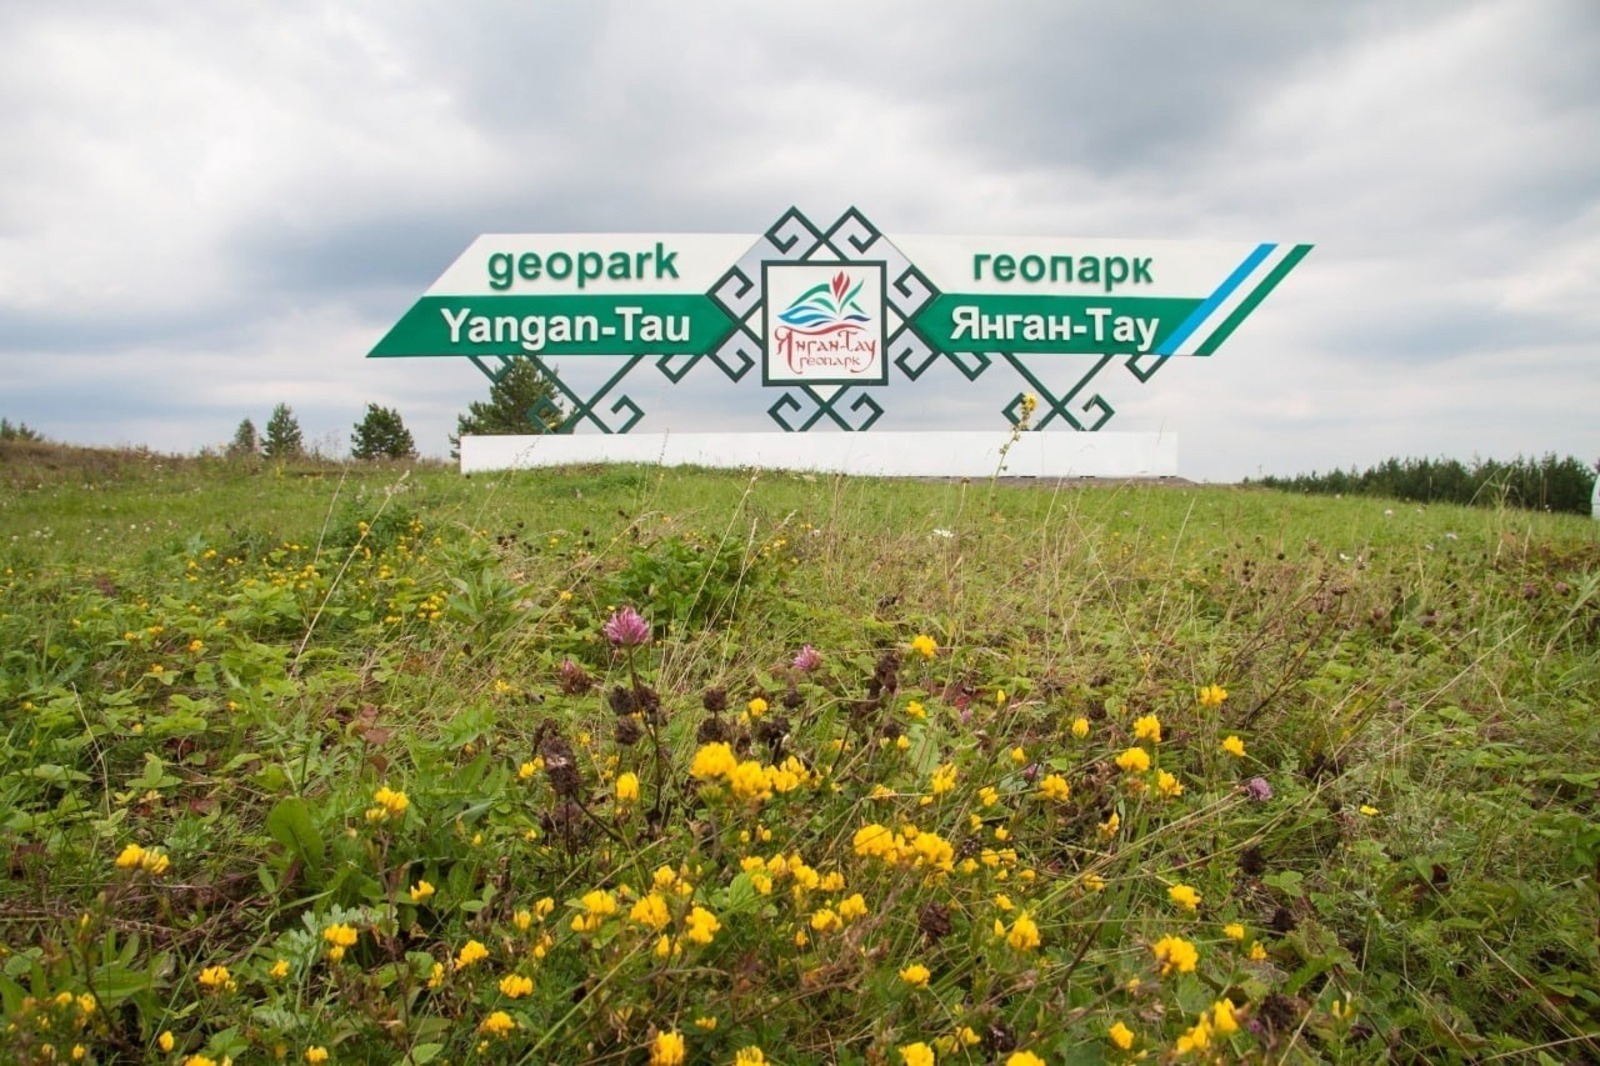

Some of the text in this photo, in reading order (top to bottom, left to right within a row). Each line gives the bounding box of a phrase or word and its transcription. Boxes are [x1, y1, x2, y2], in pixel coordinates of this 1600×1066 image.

[487, 242, 680, 291] geopark
[973, 252, 1154, 292] геопарк
[440, 306, 690, 351] Yangan-Tau
[950, 305, 1160, 352] Янган-Тау
